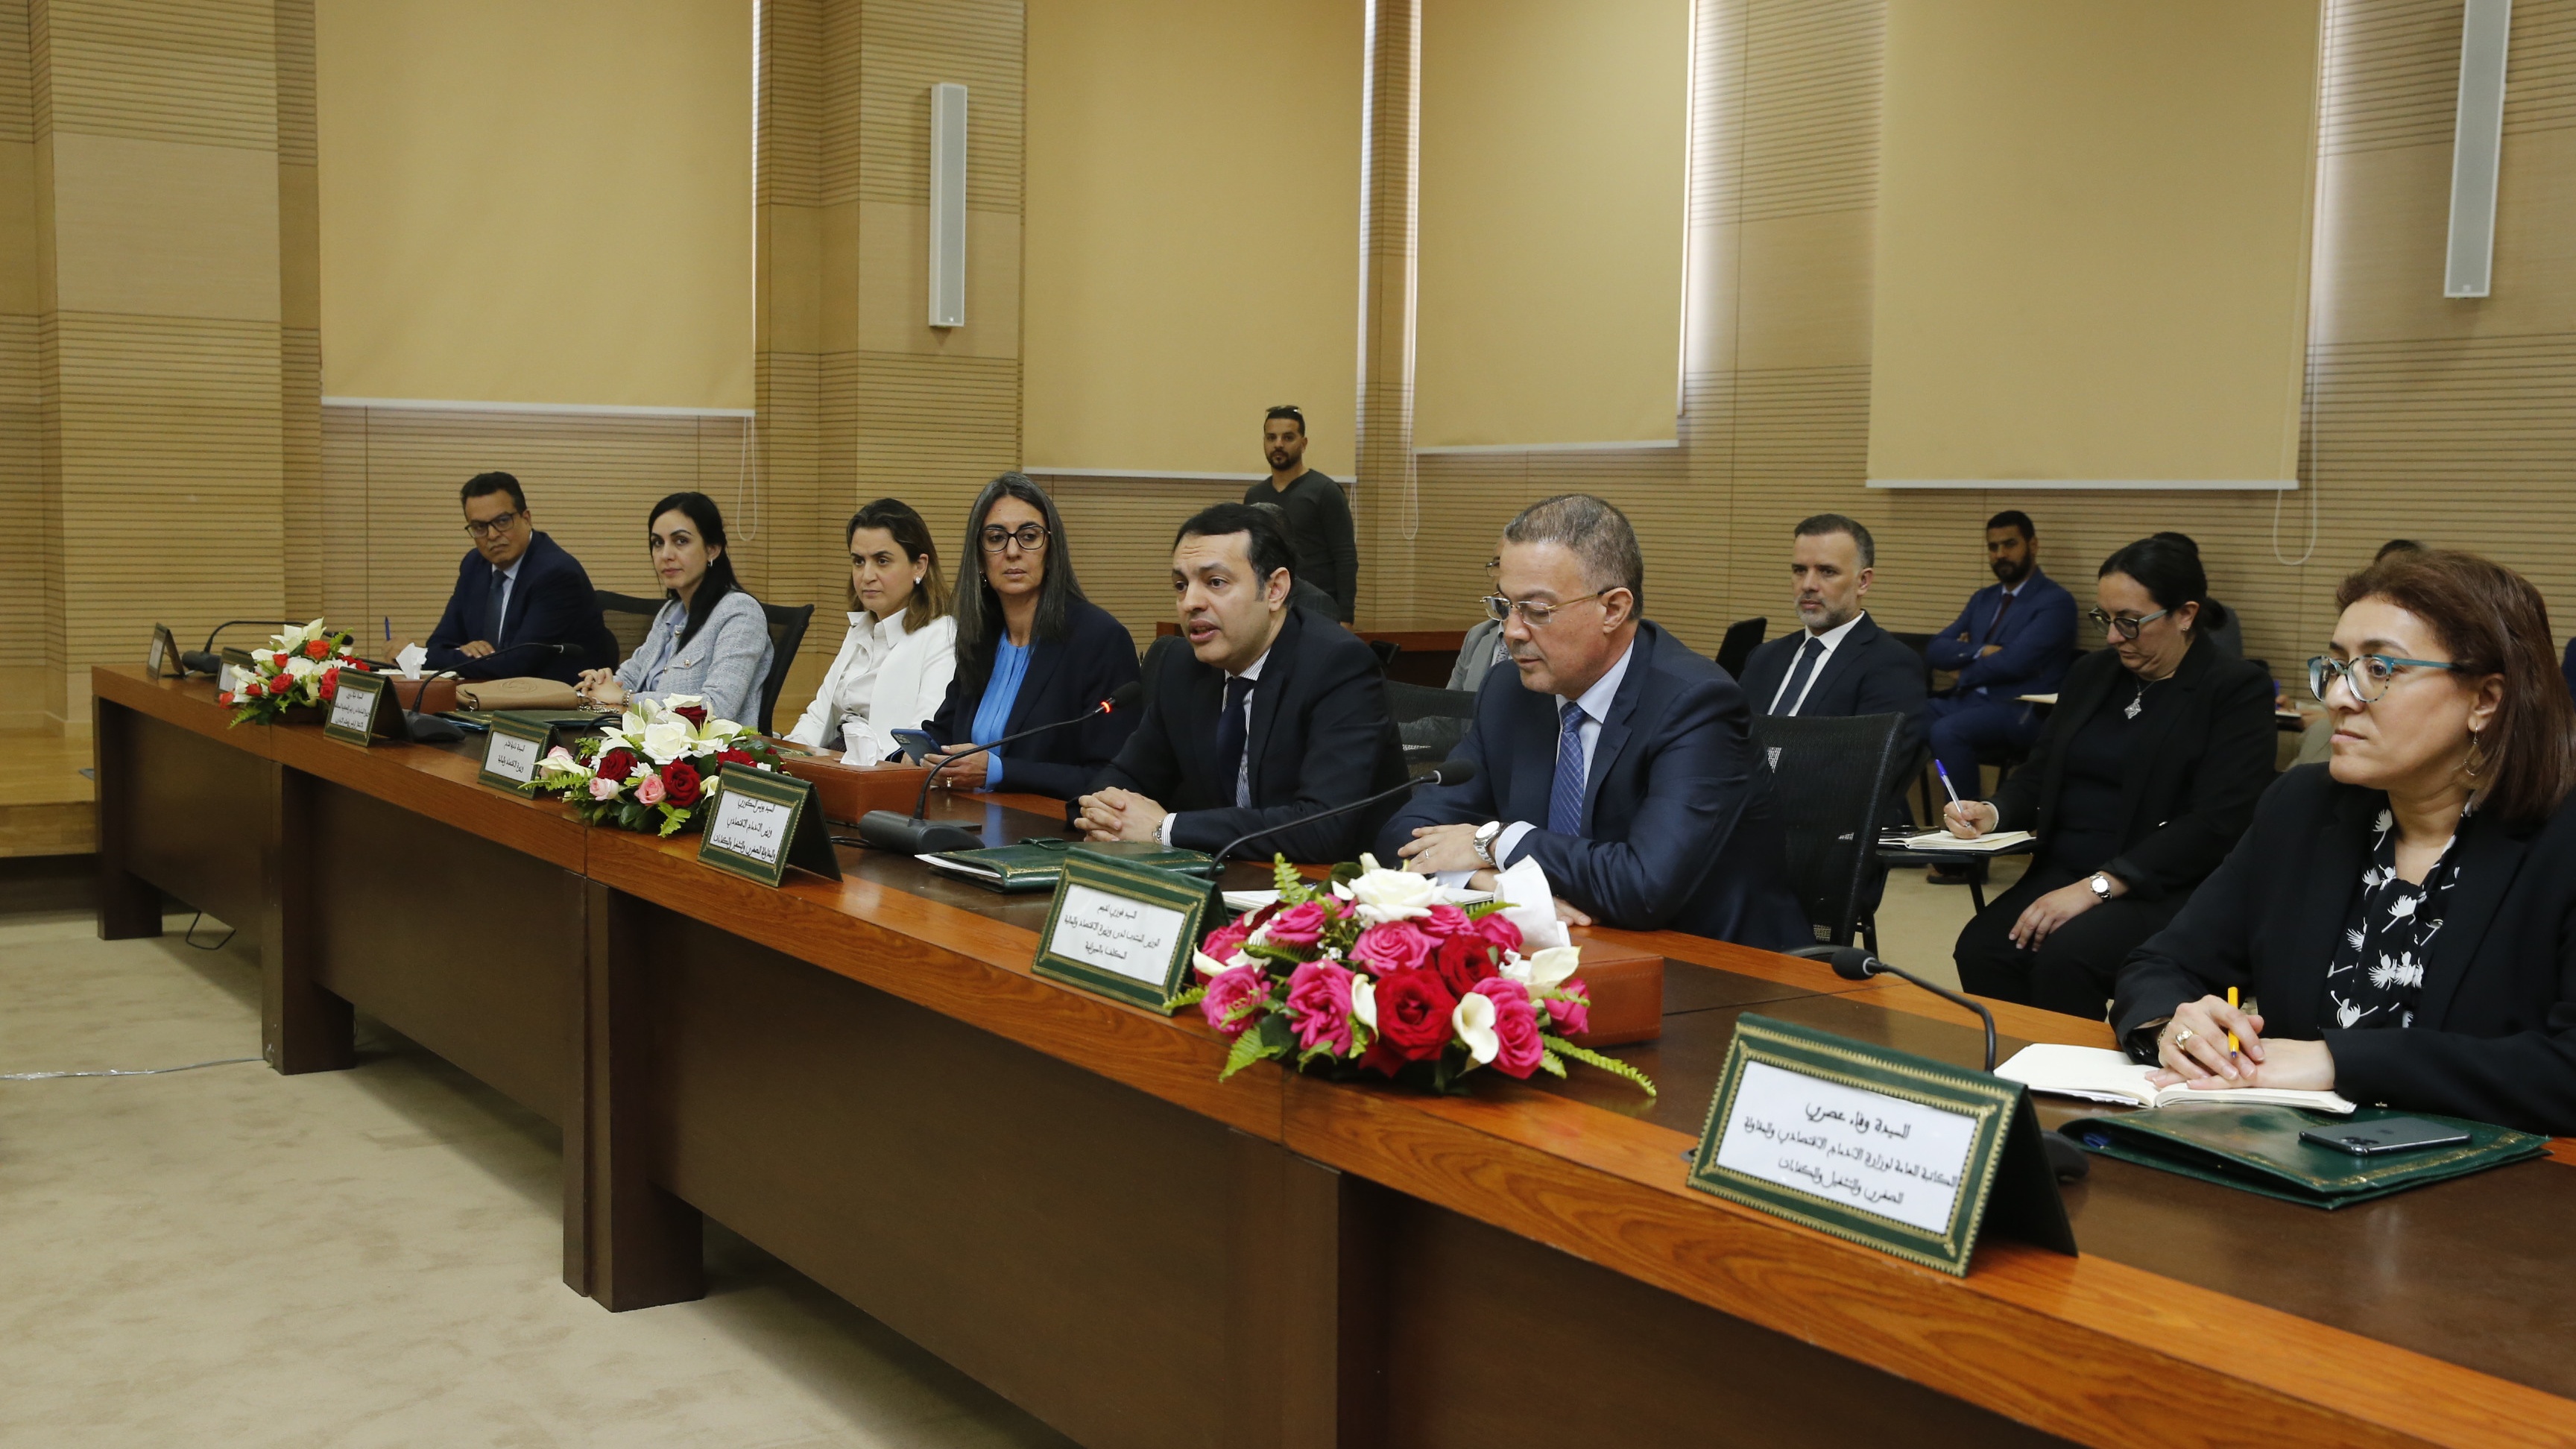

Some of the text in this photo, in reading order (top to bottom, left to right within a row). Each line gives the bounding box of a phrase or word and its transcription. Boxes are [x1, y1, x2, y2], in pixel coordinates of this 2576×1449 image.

[760, 827, 773, 838] وزير
[1744, 1117, 1775, 1139] والمقاولة
[1805, 1102, 1911, 1139] السيدة وفاء عصري
[1864, 1152, 1893, 1172] لوزارة
[1895, 1159, 1920, 1176] العامة
[1821, 1170, 1861, 1196] والتشغيل
[1922, 1167, 1958, 1187] الكاتبة
